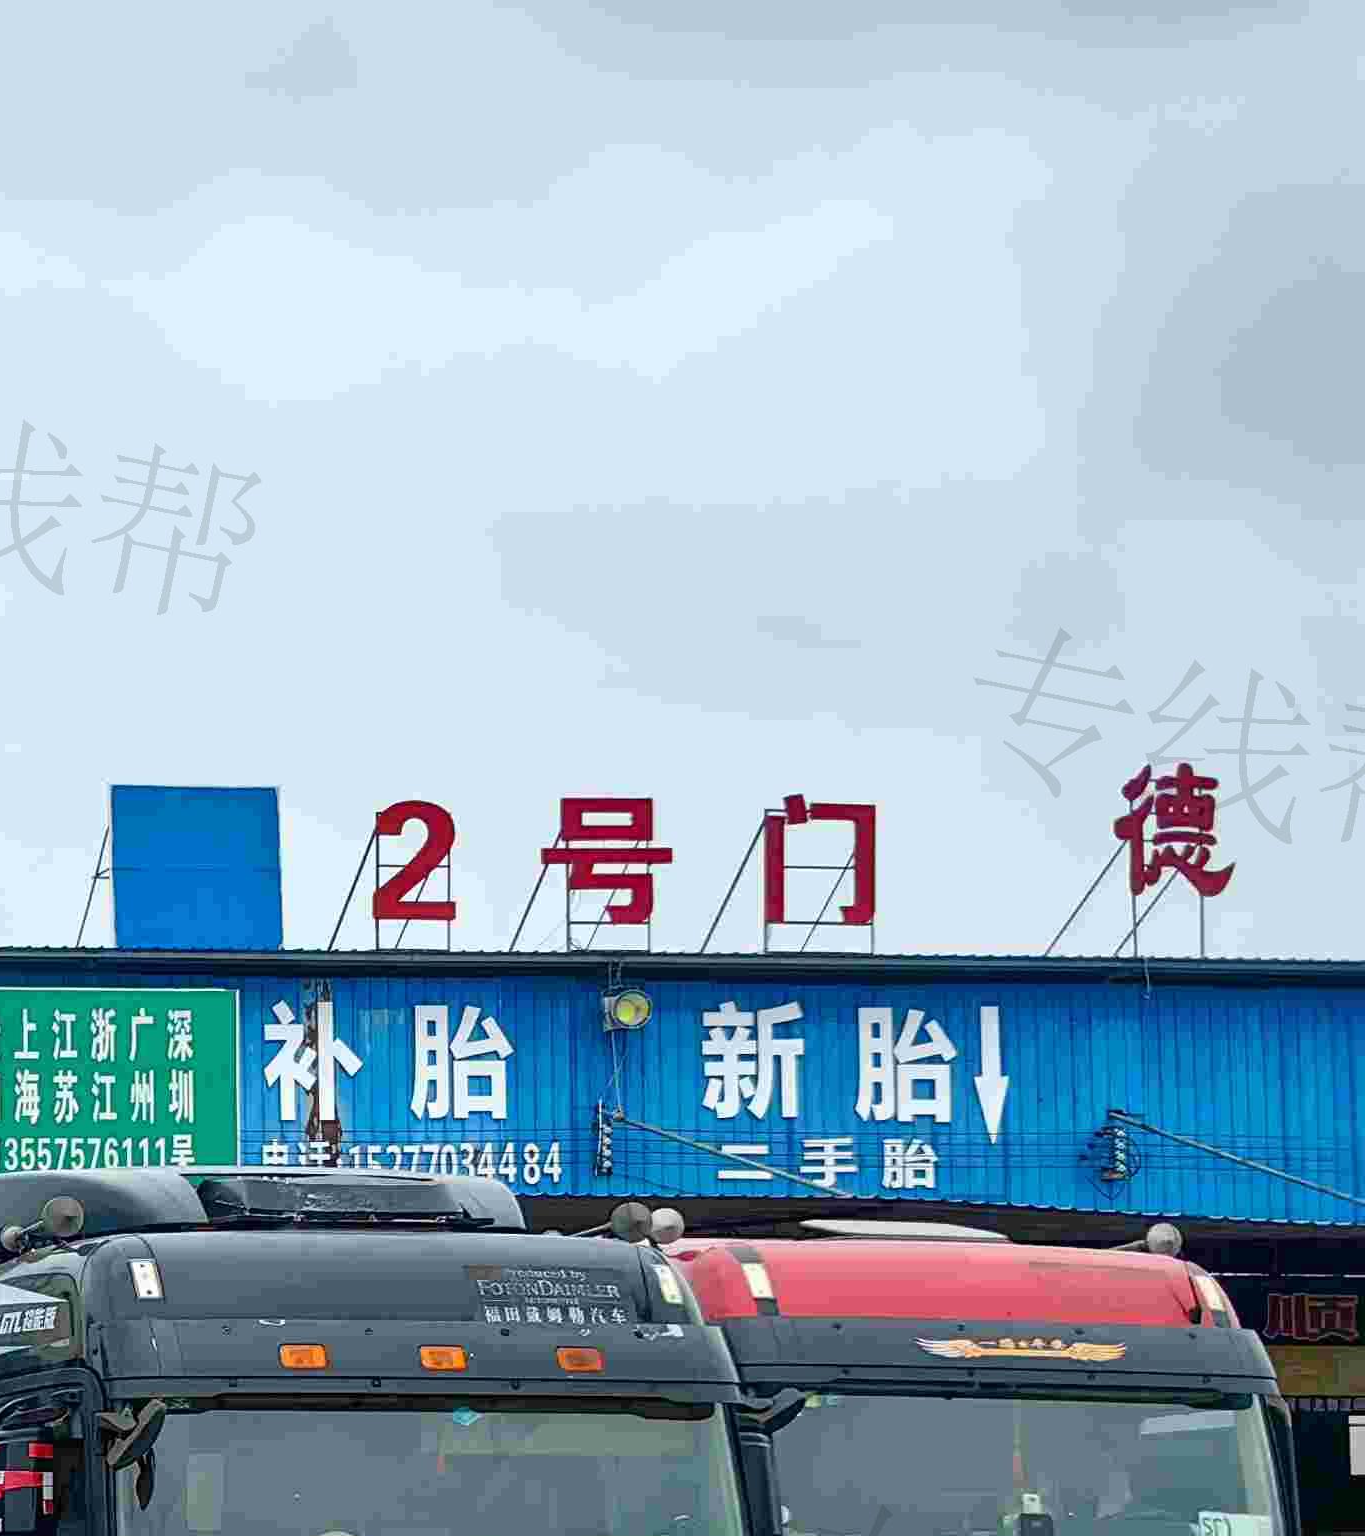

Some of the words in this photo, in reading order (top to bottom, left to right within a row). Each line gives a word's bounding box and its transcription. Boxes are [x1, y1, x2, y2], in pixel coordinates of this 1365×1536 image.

[372, 797, 876, 926] 2号门
[1114, 762, 1236, 897] 德
[13, 1009, 40, 1124] 上海
[52, 1010, 79, 1122] 江苏
[90, 1008, 117, 1121] 浙江
[129, 1007, 155, 1122] 广州
[167, 1009, 195, 1123] 深圳
[263, 1000, 514, 1121] 补胎
[701, 1000, 958, 1122] 新胎
[717, 1137, 939, 1191] 二手胎
